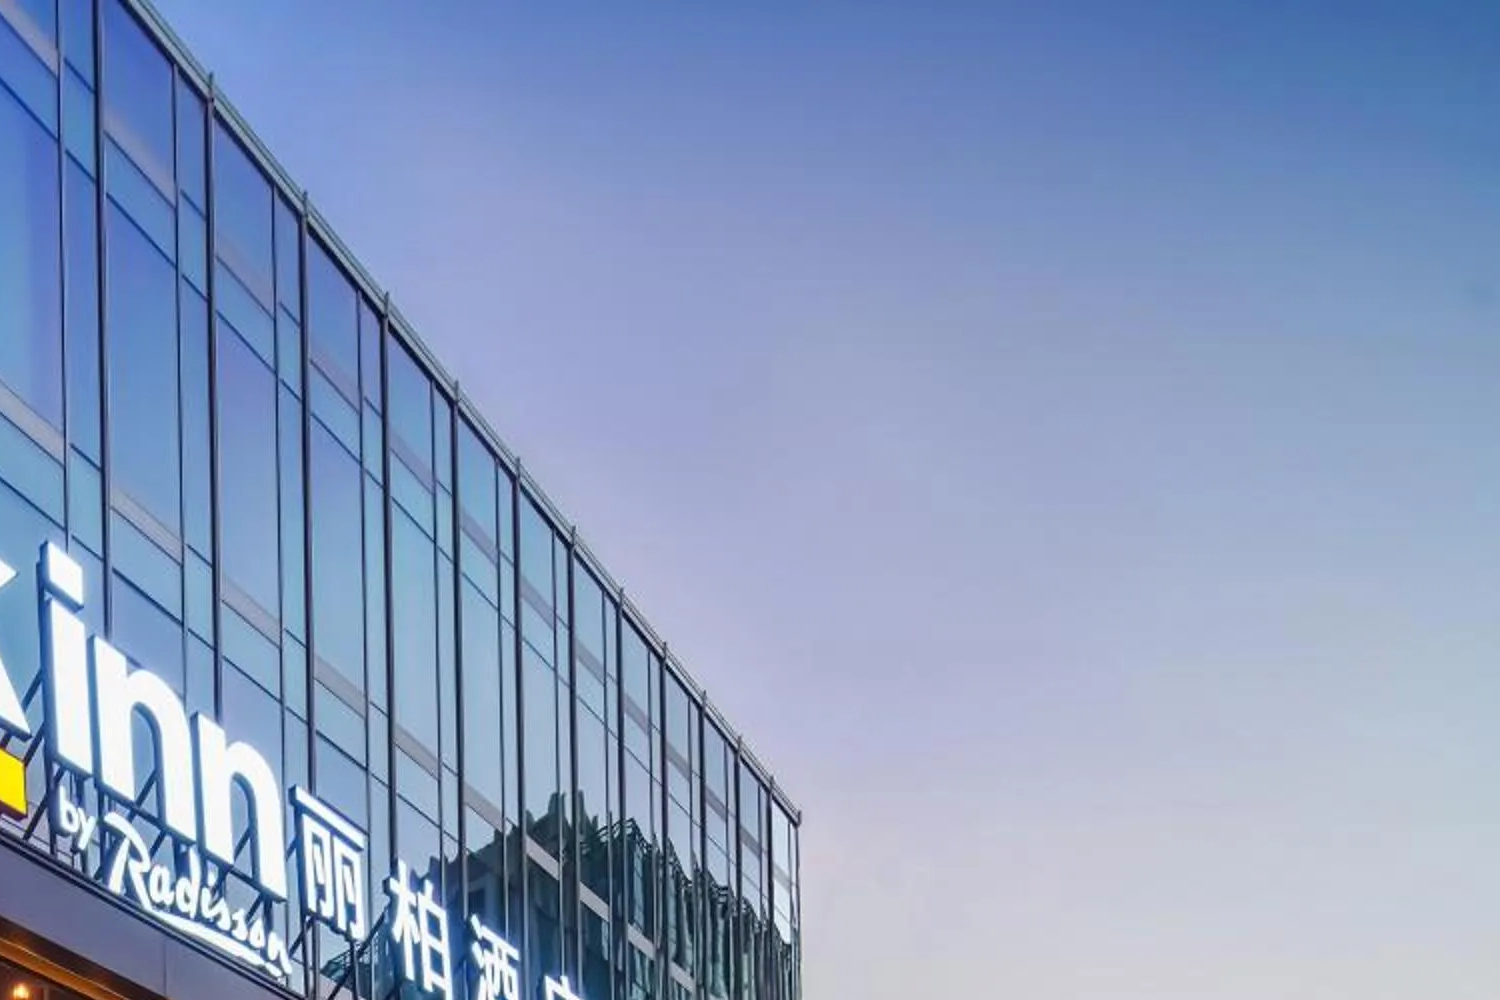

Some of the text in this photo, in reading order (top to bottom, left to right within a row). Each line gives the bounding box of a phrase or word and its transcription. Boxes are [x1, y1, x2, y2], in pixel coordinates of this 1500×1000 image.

[43, 540, 288, 901] inn
[57, 784, 293, 978] by Radisson
